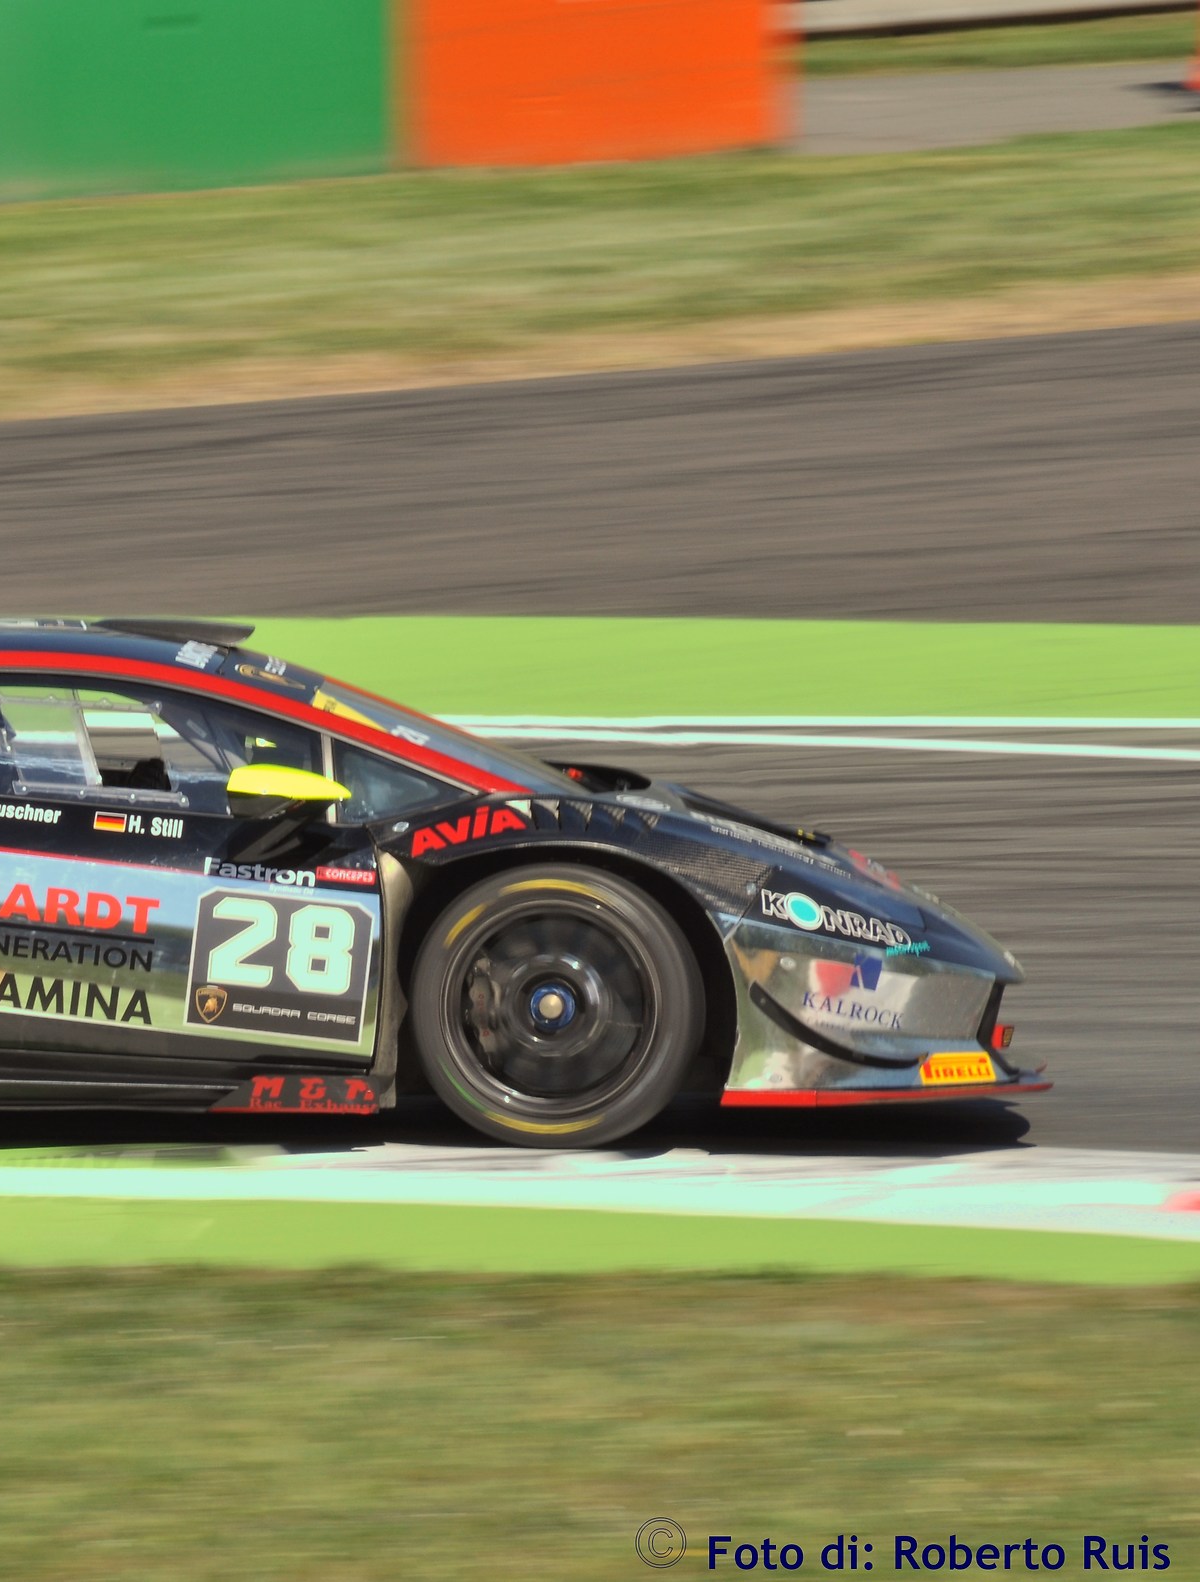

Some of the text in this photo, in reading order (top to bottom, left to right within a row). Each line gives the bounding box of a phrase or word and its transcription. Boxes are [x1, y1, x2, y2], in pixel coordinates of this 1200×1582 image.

[128, 815, 184, 839] H. Still
[204, 856, 316, 887] Fastron
[761, 889, 912, 948] KONRAD
[207, 896, 356, 996] 28
[232, 1003, 357, 1026] SQUADRA CORSE
[803, 991, 904, 1030] KALROCK
[923, 1057, 991, 1079] PIRELLI
[251, 1077, 285, 1098] M
